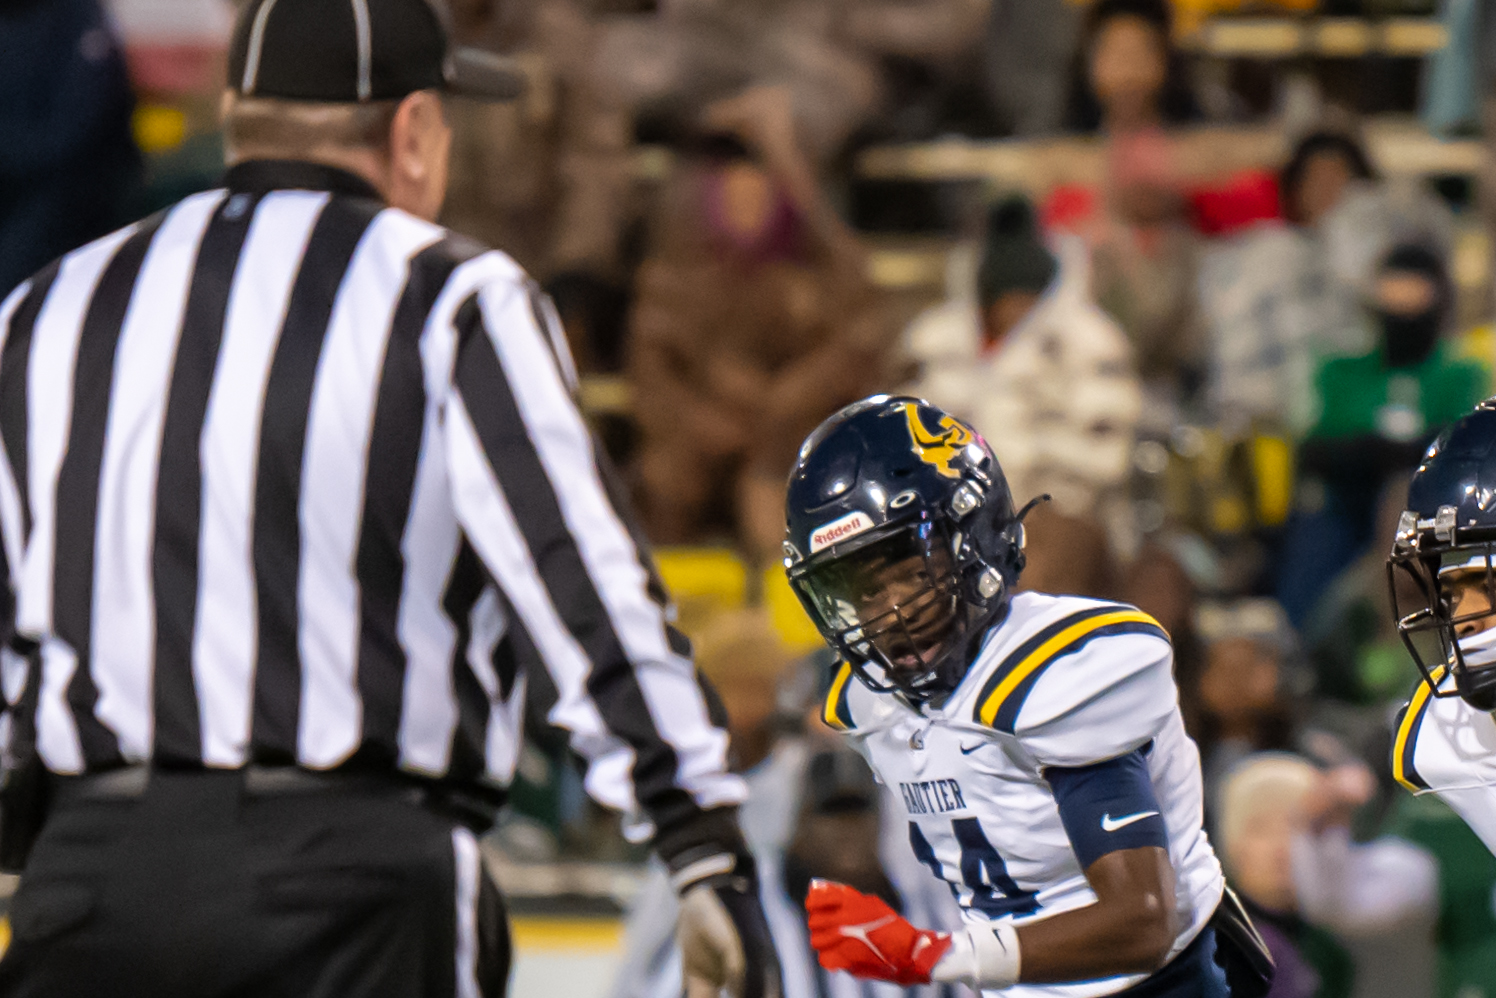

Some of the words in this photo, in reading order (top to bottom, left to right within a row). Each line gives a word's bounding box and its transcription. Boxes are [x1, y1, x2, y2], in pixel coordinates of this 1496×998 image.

[813, 517, 862, 545] Riddell
[899, 777, 967, 815] GAUTIER
[908, 816, 1044, 921] 14
